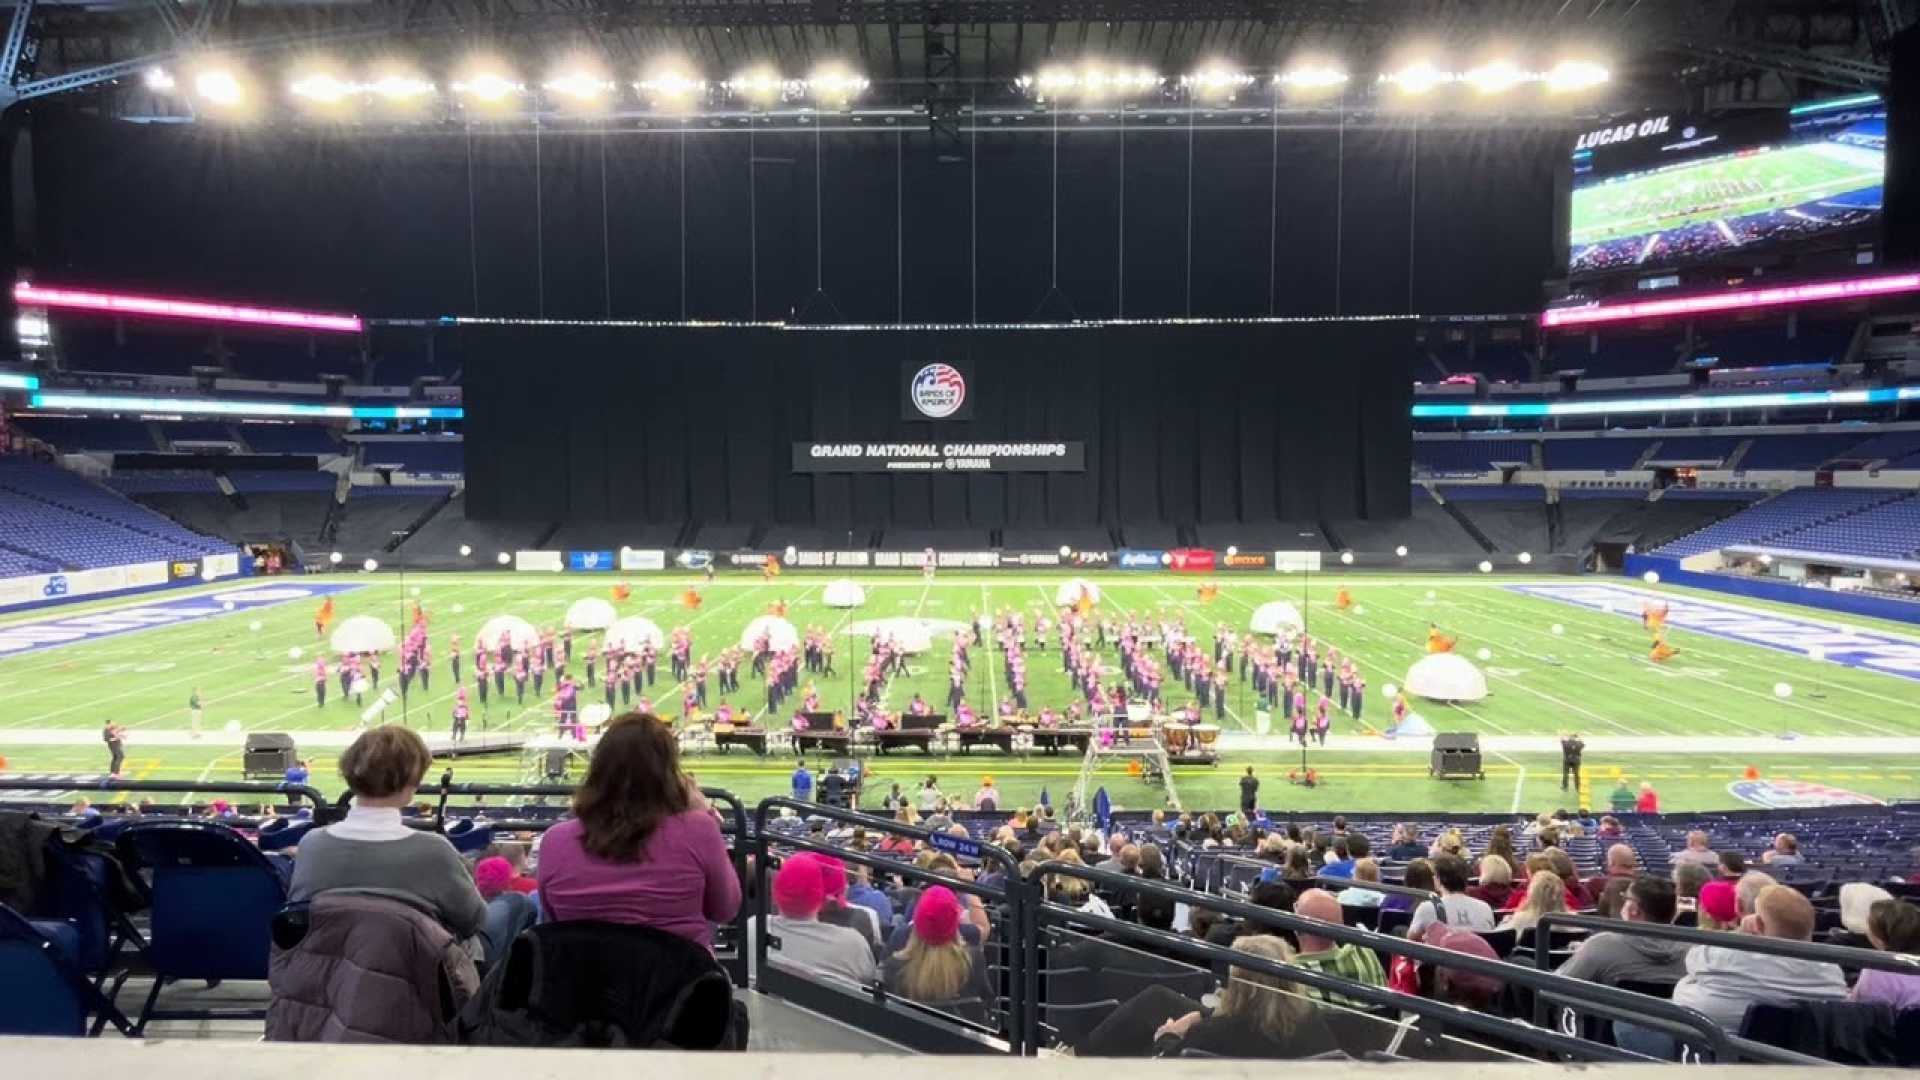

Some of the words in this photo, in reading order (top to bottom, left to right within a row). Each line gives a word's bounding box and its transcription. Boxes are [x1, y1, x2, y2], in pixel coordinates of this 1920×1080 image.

[1575, 123, 1637, 150] LUCAS
[1639, 116, 1670, 136] OIL
[810, 444, 863, 457] GRAND
[866, 444, 939, 457] NATIONAL
[943, 443, 1066, 457] CHAMPIONSHIPS
[938, 837, 956, 849] ROW
